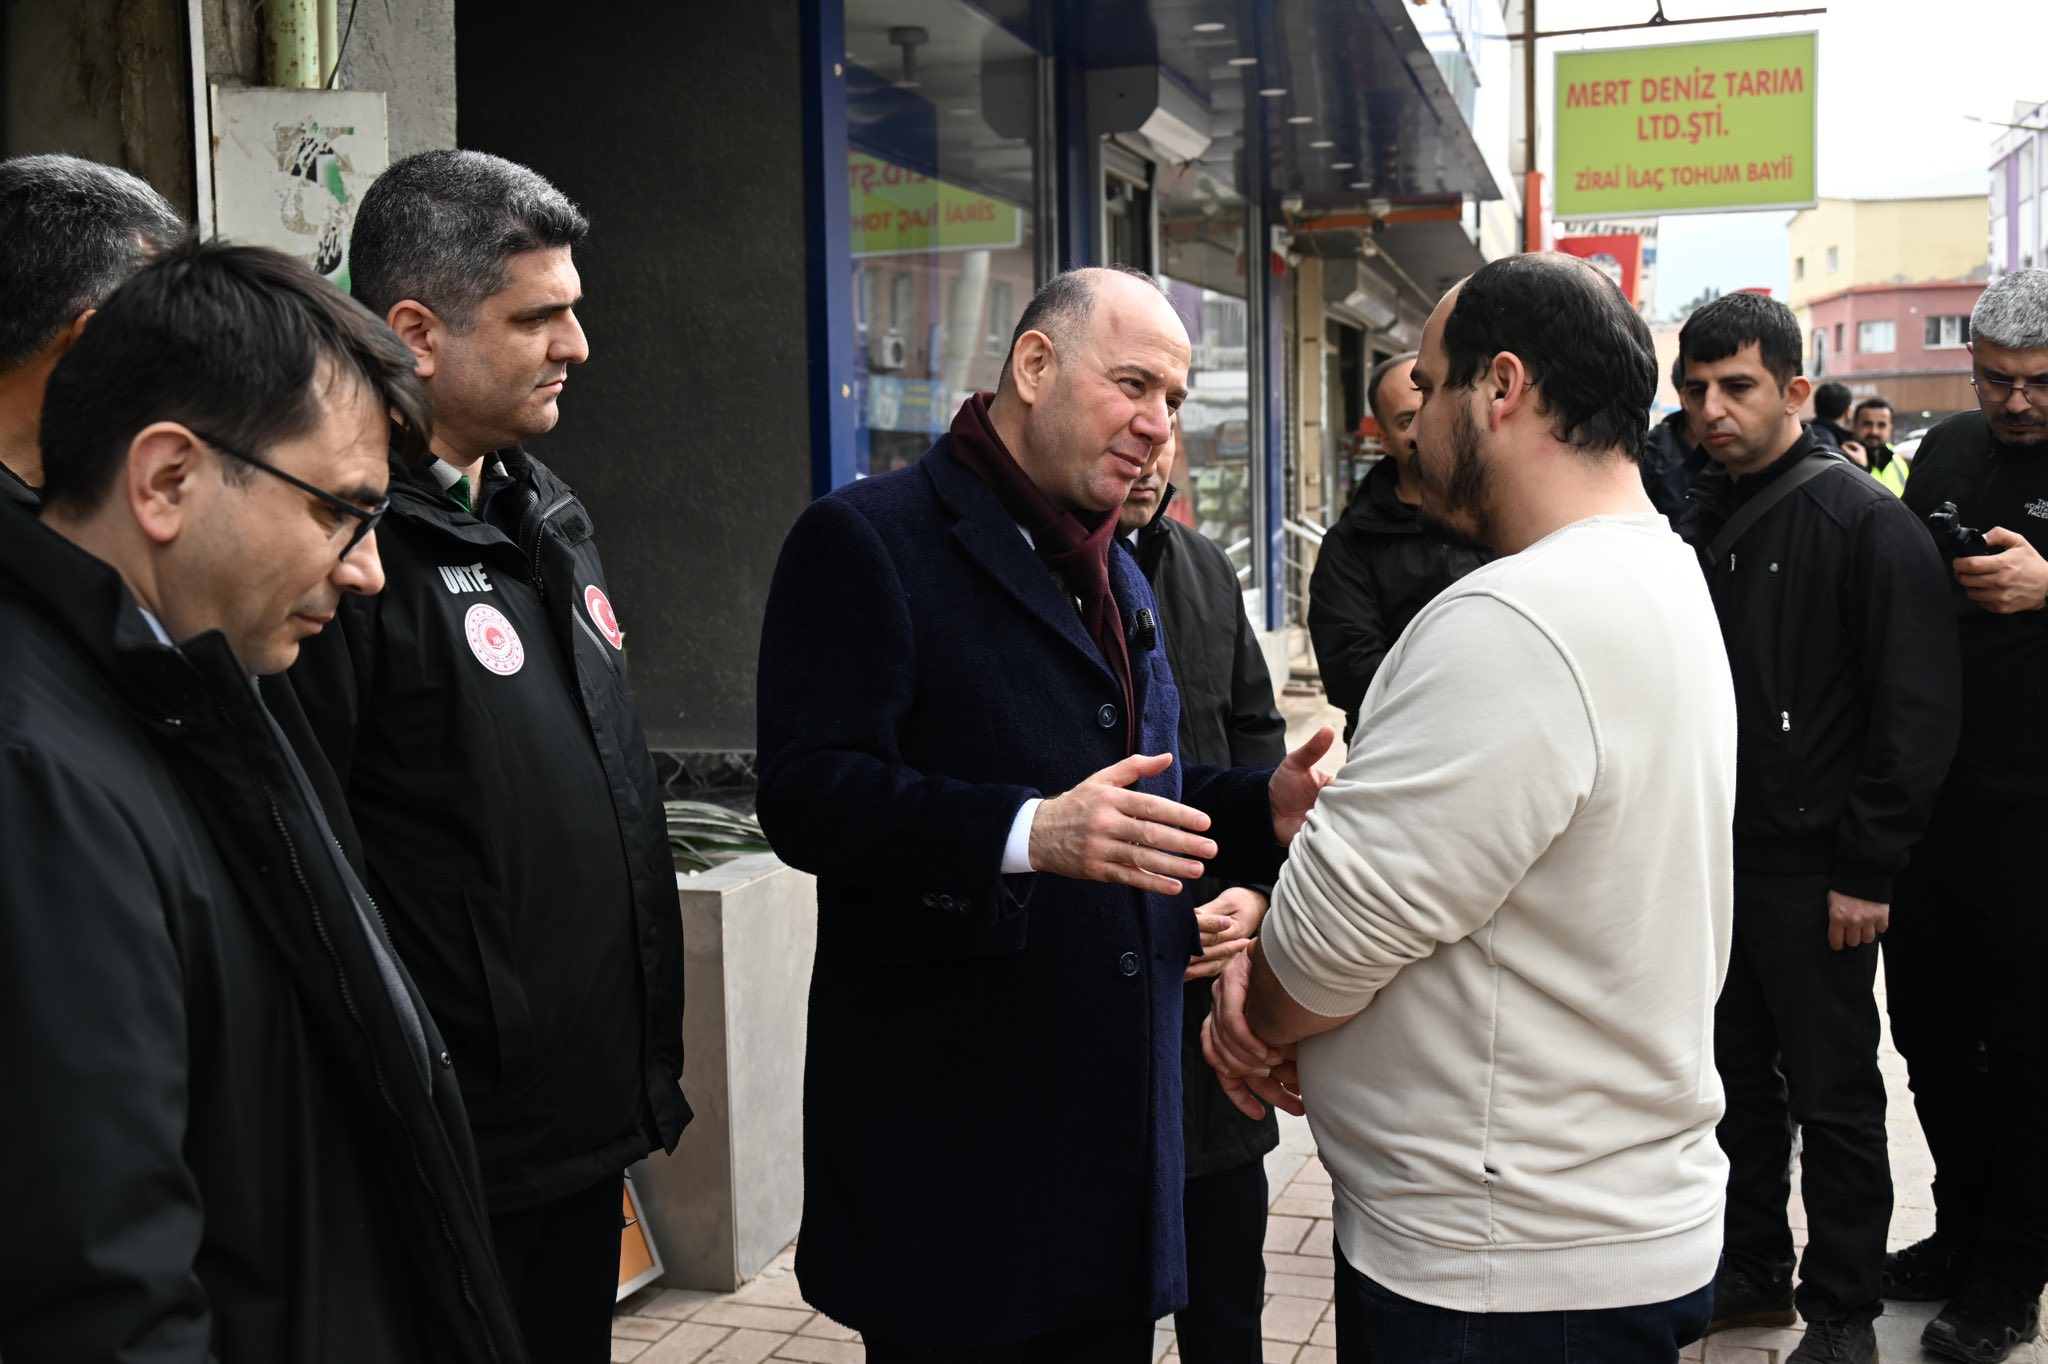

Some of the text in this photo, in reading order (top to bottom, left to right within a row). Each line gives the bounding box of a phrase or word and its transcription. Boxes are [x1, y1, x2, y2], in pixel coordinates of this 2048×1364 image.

[1566, 66, 1804, 109] MERT DENİZ TARIM
[1637, 103, 1728, 144] LTD.ŞTİ.
[1575, 155, 1793, 192] ZİRAİ İLAÇ TOHUM BAYİİ
